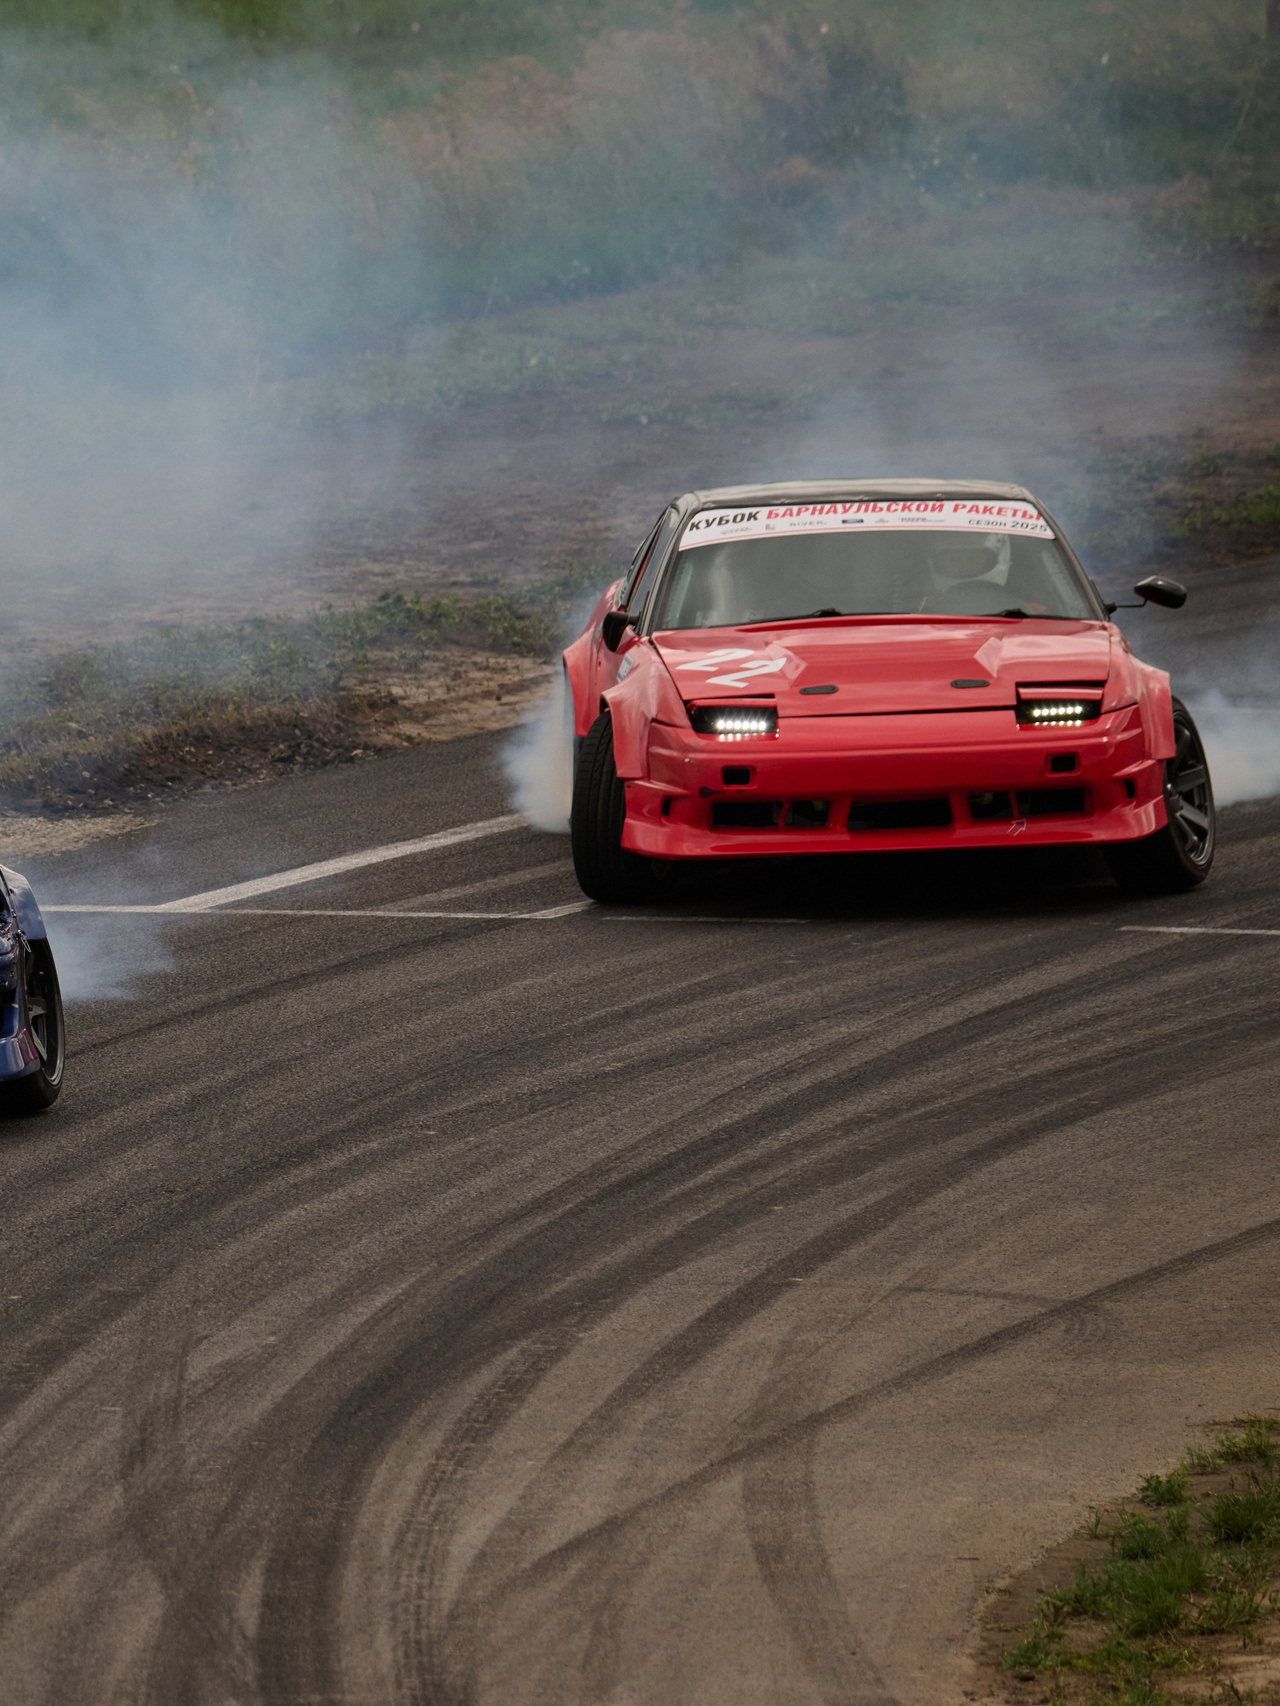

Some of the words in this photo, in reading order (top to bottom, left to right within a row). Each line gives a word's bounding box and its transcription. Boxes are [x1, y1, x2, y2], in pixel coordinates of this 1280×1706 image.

[688, 510, 761, 531] КУБОК
[766, 501, 945, 519] БАРНАУЛЬСКОЙ
[952, 503, 1042, 520] РАКЕТЫ
[968, 519, 1007, 527] СЕЗОН
[1011, 521, 1048, 532] 2025
[675, 648, 787, 688] 22
